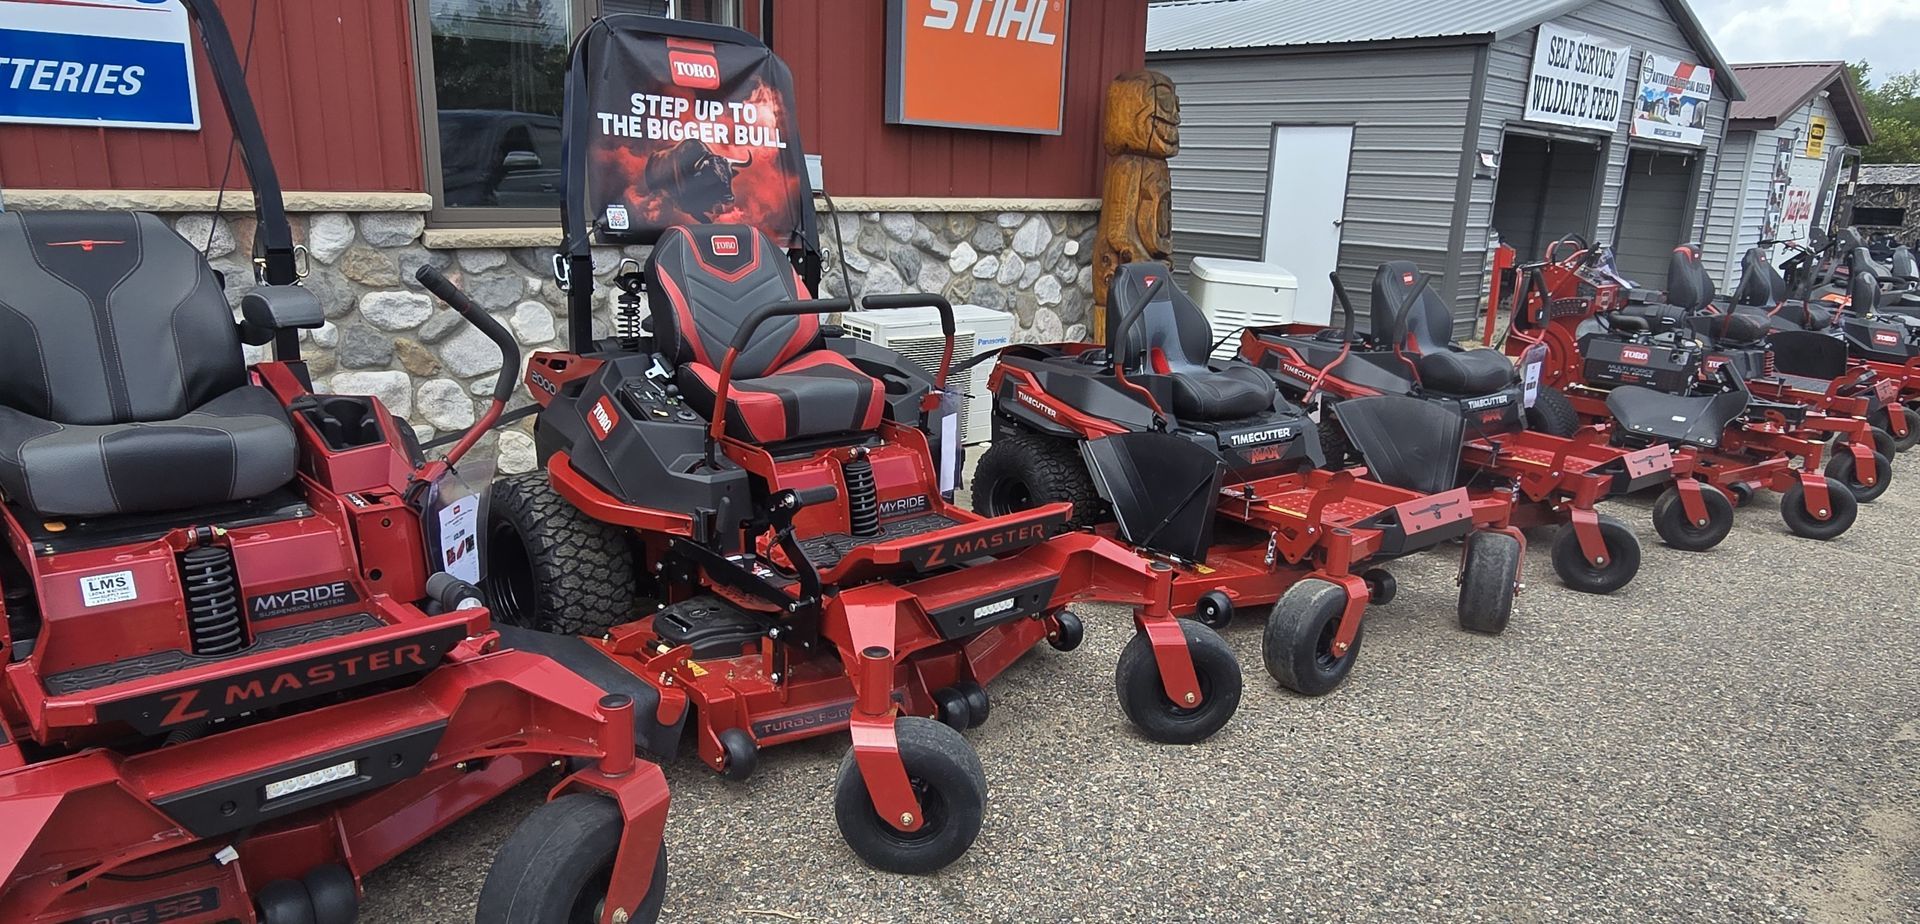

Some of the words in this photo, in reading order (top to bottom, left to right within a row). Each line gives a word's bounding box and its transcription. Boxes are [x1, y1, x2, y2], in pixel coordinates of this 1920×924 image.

[923, 0, 1056, 46] STIHL
[1547, 35, 1576, 70] SELF
[1576, 42, 1618, 79] SERVICE
[631, 92, 690, 119] STEP
[694, 99, 724, 122] UP
[728, 102, 757, 124] TO
[1532, 74, 1589, 117] WILDLIFE
[1589, 86, 1619, 122] FEED
[597, 112, 643, 139] THE
[647, 117, 729, 145] BIGGER
[734, 124, 787, 149] BULL
[715, 241, 736, 250] TORO
[978, 336, 1007, 346] Panasonic
[1876, 334, 1897, 343] TORO
[1623, 350, 1649, 360] TORO
[1018, 390, 1057, 418] TIMECUTTER
[1468, 395, 1508, 409] TIMECUTTER
[1231, 427, 1291, 446] TIMECUTTER
[1250, 443, 1281, 465] MAX
[924, 545, 948, 568] Z
[953, 524, 1045, 557] MASTER
[89, 577, 127, 592] LMS
[259, 604, 311, 618] SUSPENSION
[312, 598, 345, 608] SYSTEM
[159, 689, 210, 727] Z
[224, 643, 427, 706] MASTER
[762, 716, 816, 735] TURBO
[154, 896, 203, 919] 52
